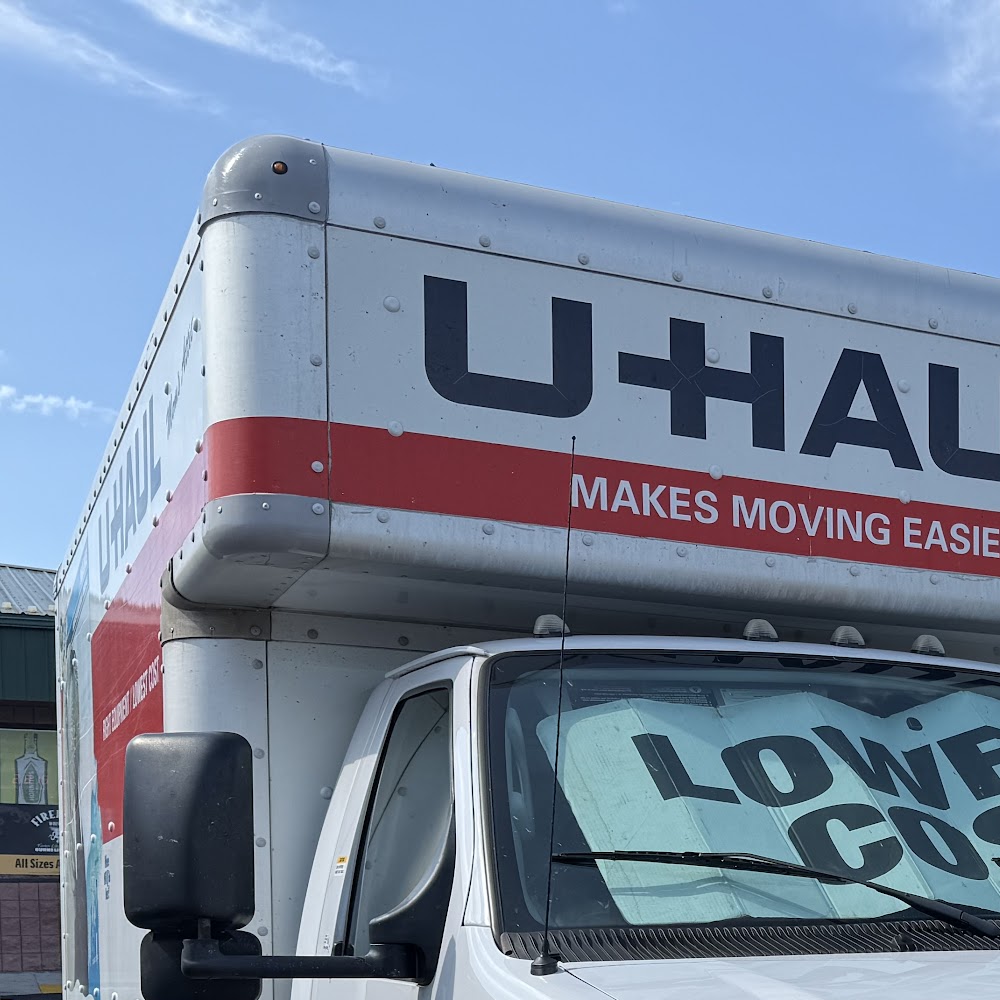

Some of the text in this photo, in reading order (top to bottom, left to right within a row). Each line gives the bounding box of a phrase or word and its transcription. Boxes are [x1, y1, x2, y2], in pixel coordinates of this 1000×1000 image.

[570, 473, 719, 524] MAKES
[732, 494, 890, 546] MOVING
[15, 858, 28, 869] All
[30, 858, 54, 869] Sizes
